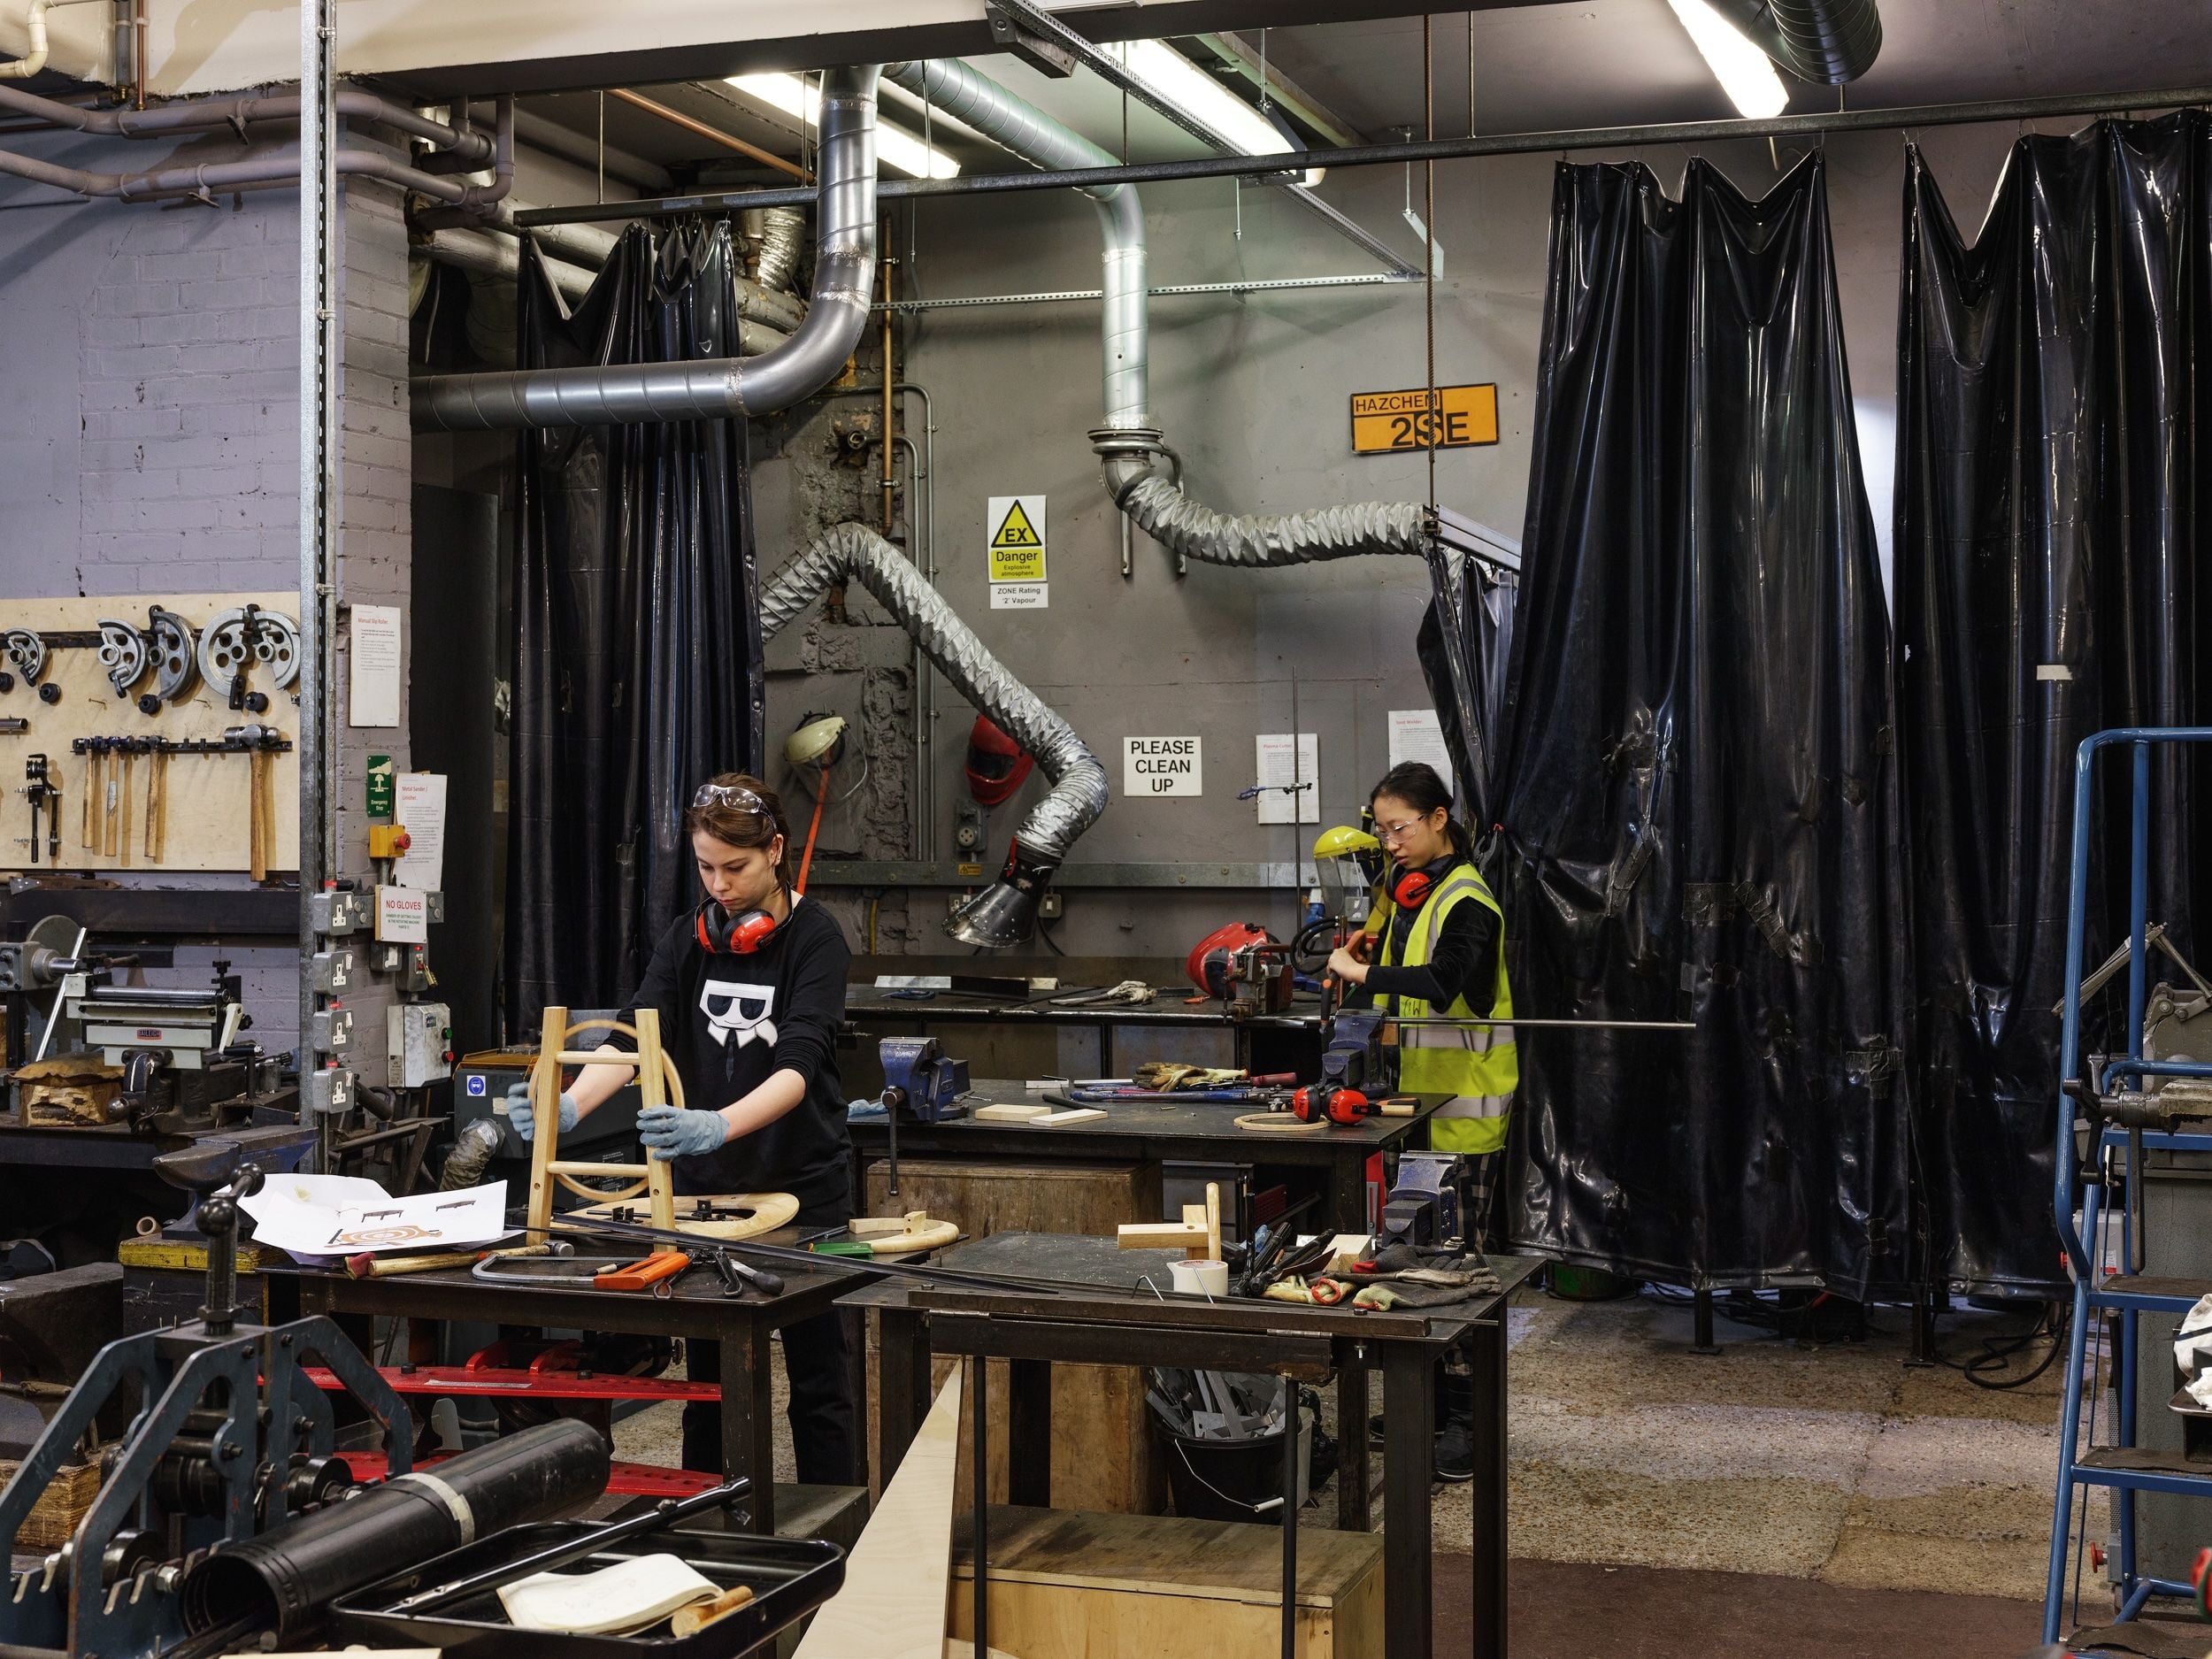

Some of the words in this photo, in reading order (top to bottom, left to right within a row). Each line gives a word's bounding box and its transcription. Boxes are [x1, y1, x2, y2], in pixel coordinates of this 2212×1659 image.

[1390, 411, 1470, 447] 2SE
[1004, 527, 1028, 542] EX
[996, 551, 1038, 564] Danger
[1018, 587, 1041, 595] Rating
[1131, 741, 1194, 755] PLEASE
[1135, 759, 1191, 774] CLEAN
[1152, 779, 1174, 793] UP
[386, 900, 395, 909] NO
[396, 901, 421, 910] GLOVES
